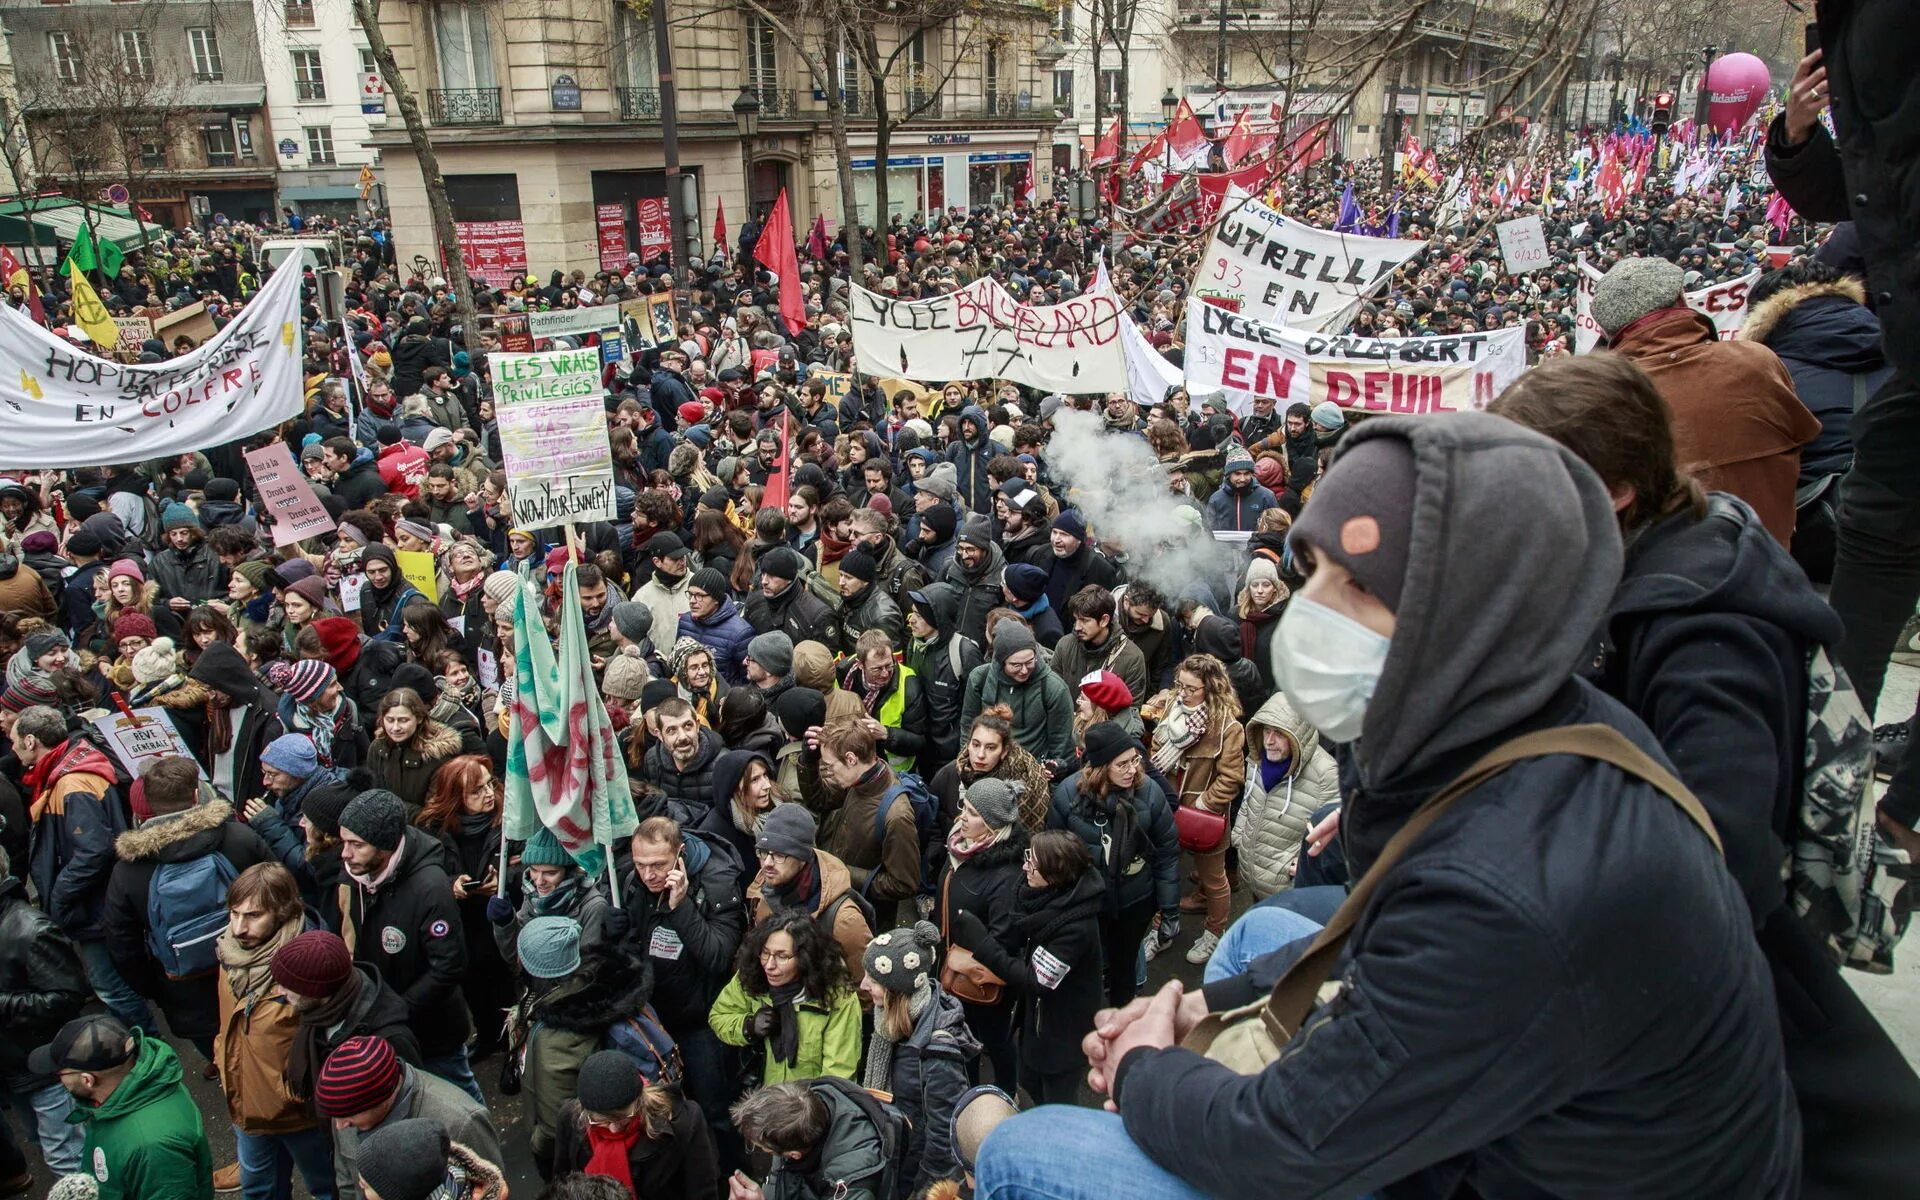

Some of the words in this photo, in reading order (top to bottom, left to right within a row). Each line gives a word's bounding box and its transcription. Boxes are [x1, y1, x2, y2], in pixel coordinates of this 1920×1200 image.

[1710, 92, 1749, 104] lidaires
[1213, 258, 1242, 288] 93
[1262, 281, 1320, 315] EN
[531, 315, 575, 327] Pathfinder
[501, 357, 543, 382] LES
[1221, 347, 1297, 398] EN
[1326, 371, 1458, 414] DEUIL
[76, 404, 114, 422] EN
[500, 412, 515, 424] NE
[536, 417, 570, 437] PAS
[536, 437, 574, 448] LEURS
[252, 461, 266, 473] Droit
[271, 458, 279, 467] la
[266, 487, 285, 498] Droit
[286, 484, 297, 492] au
[276, 496, 300, 508] repos
[288, 508, 309, 520] Droit
[310, 505, 321, 513] au
[292, 515, 328, 532] bonheur
